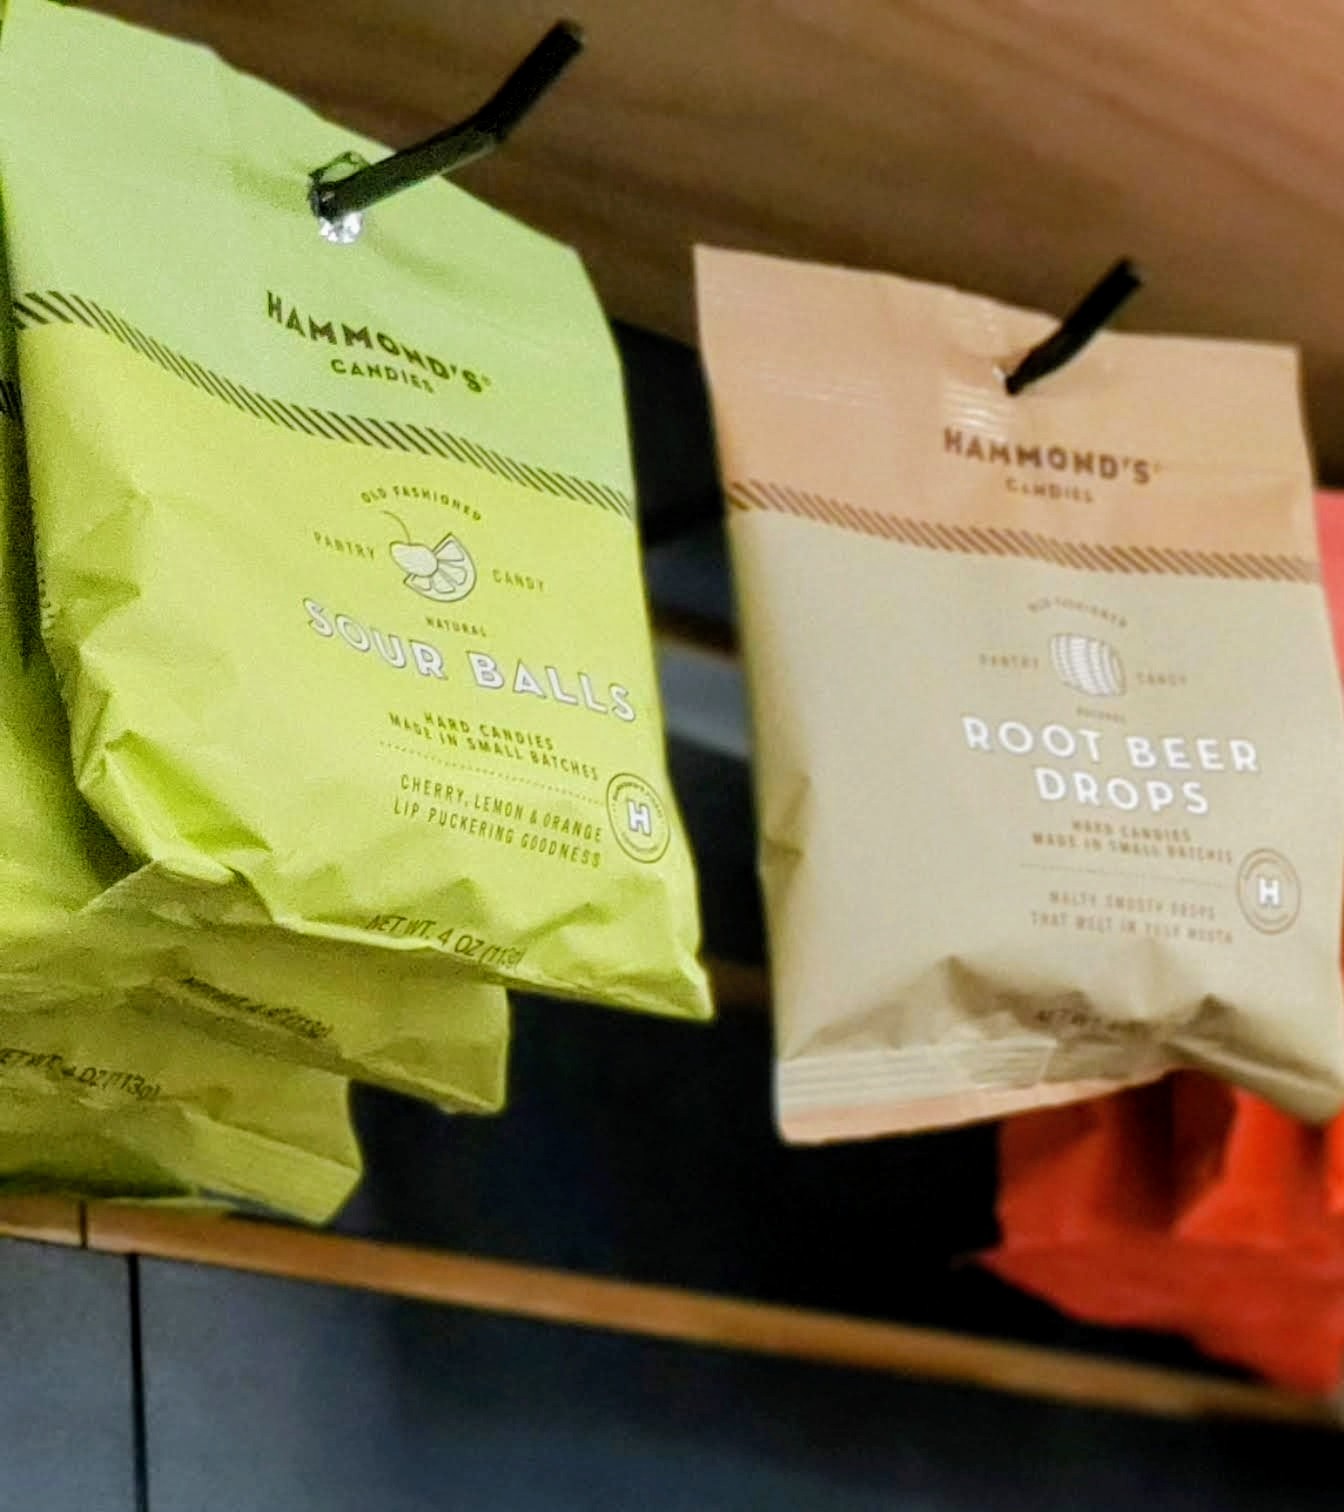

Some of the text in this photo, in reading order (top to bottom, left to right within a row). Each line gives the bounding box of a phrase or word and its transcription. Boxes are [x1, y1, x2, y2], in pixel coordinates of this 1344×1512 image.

[266, 289, 484, 393] HAMMOND'S
[331, 358, 435, 394] CANDIES
[943, 427, 1152, 486] HAMMOND'S
[360, 485, 483, 522] OLD FASHIONED
[1005, 477, 1094, 504] CANDIES
[313, 530, 376, 560] PANTRY
[492, 568, 546, 593] CANDY
[425, 616, 488, 638] NATURAL
[303, 597, 637, 722] SOUR BALLS
[388, 711, 600, 782] MADE IN SMALL BATCHES
[423, 712, 555, 751] HARD CANDIES
[961, 715, 1260, 773] ROOT BEER
[400, 774, 470, 808] CHERRY,
[474, 793, 523, 820] LEMON
[529, 808, 538, 825] &
[543, 813, 603, 844] ORANGE
[1033, 766, 1211, 816] DROPS
[393, 797, 420, 819] LIP
[428, 809, 514, 845] PUCKERING
[520, 833, 602, 869] GOODNESS
[627, 799, 652, 837] H
[366, 914, 406, 933] NET
[437, 928, 455, 946] 4
[454, 934, 485, 957] OZ
